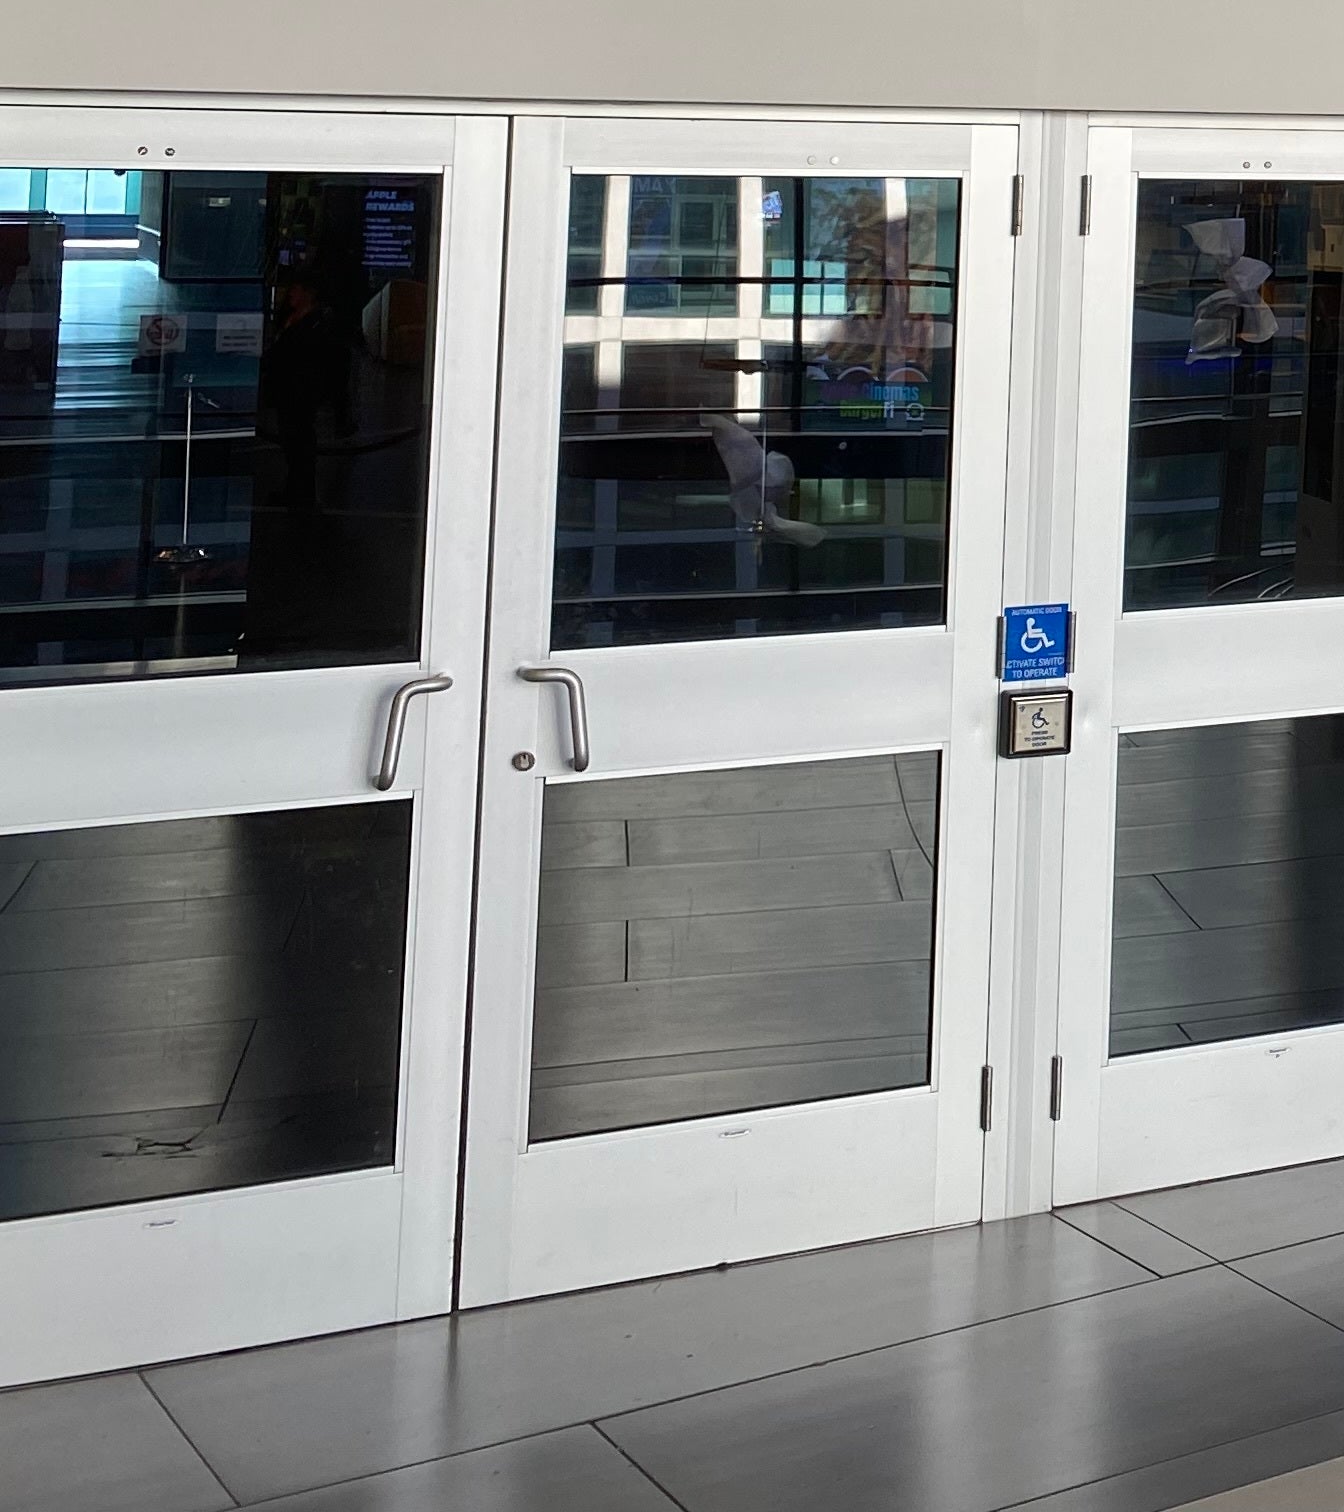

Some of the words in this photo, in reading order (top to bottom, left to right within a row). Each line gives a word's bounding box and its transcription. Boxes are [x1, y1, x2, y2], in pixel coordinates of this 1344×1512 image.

[1011, 607, 1044, 616] AUTOMATIC
[1045, 606, 1062, 615] DOOR
[1006, 659, 1038, 669] CTIVATE
[1012, 669, 1022, 679] TO
[1024, 667, 1057, 678] OPERATE
